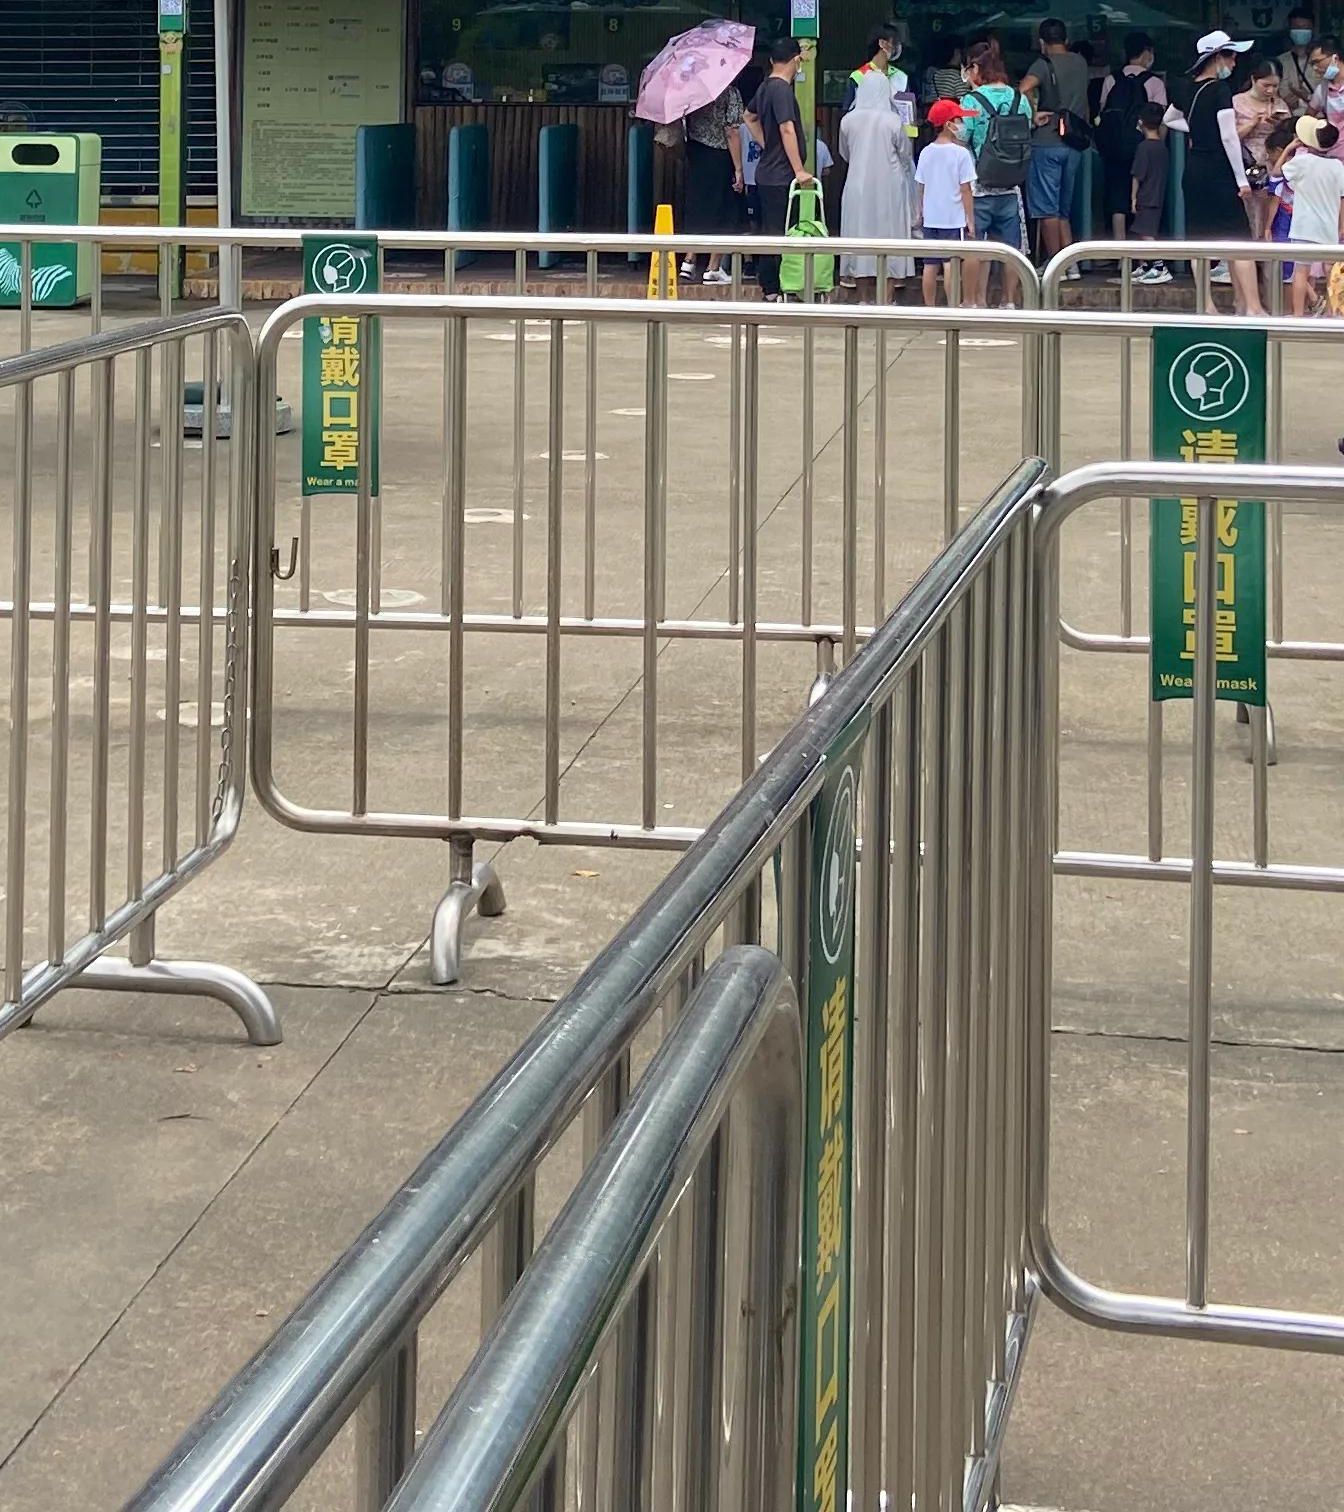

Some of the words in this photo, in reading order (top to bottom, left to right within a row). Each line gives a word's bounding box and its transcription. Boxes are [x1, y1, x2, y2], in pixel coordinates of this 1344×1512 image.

[451, 17, 462, 32] 9
[608, 18, 619, 32] 8
[306, 475, 333, 487] Wear
[1160, 673, 1193, 688] Wea
[1216, 676, 1258, 691] mask
